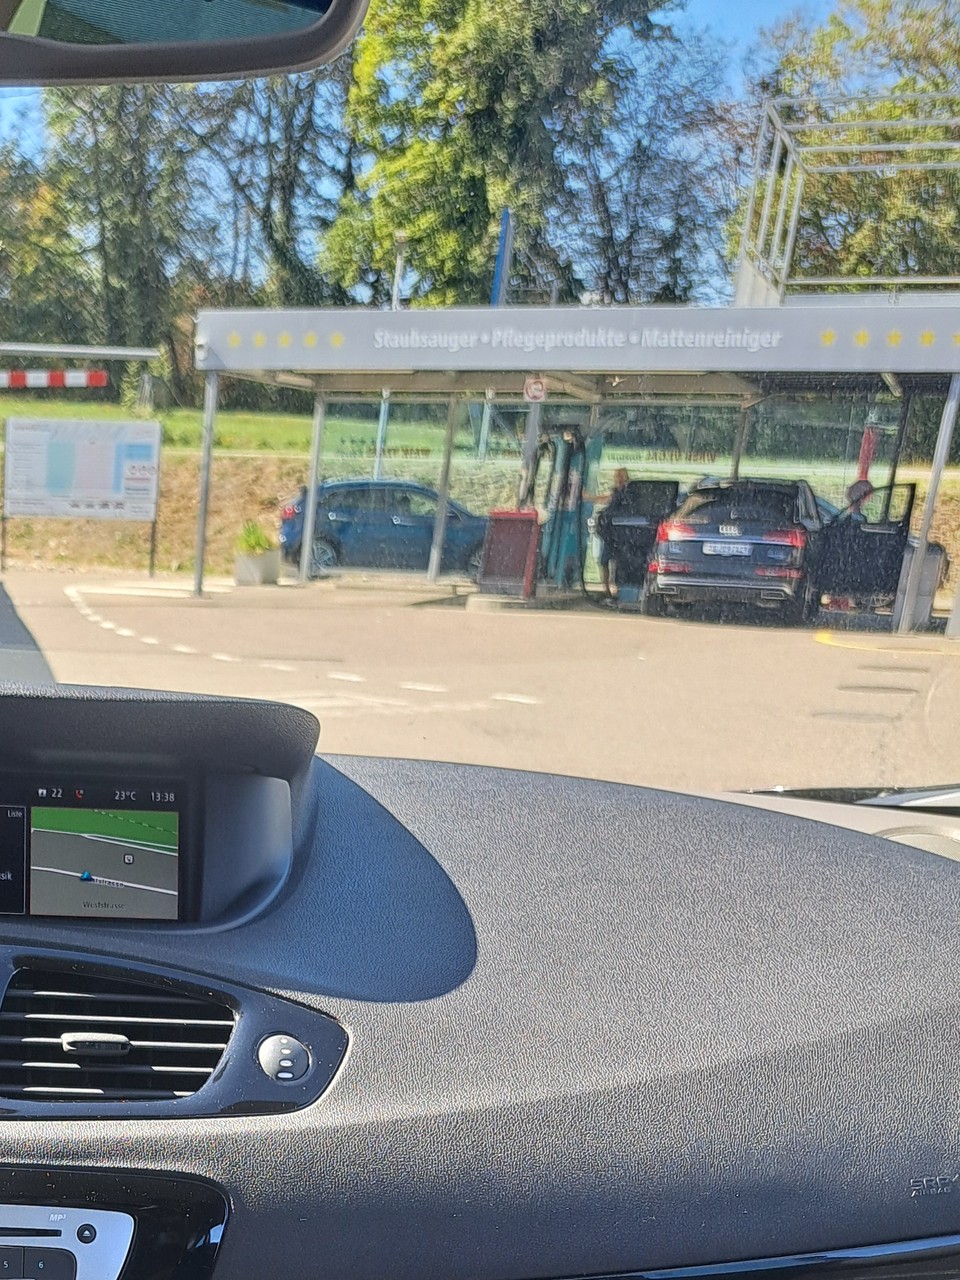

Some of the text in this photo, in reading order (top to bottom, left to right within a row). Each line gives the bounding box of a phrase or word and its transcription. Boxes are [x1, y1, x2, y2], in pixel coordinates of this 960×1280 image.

[373, 327, 783, 353] Staubsauger Pflegeprodukte Mattenreiniger
[51, 788, 63, 798] 22
[114, 790, 136, 801] 23°C
[151, 791, 175, 802] 13:38
[38, 1261, 44, 1269] 6
